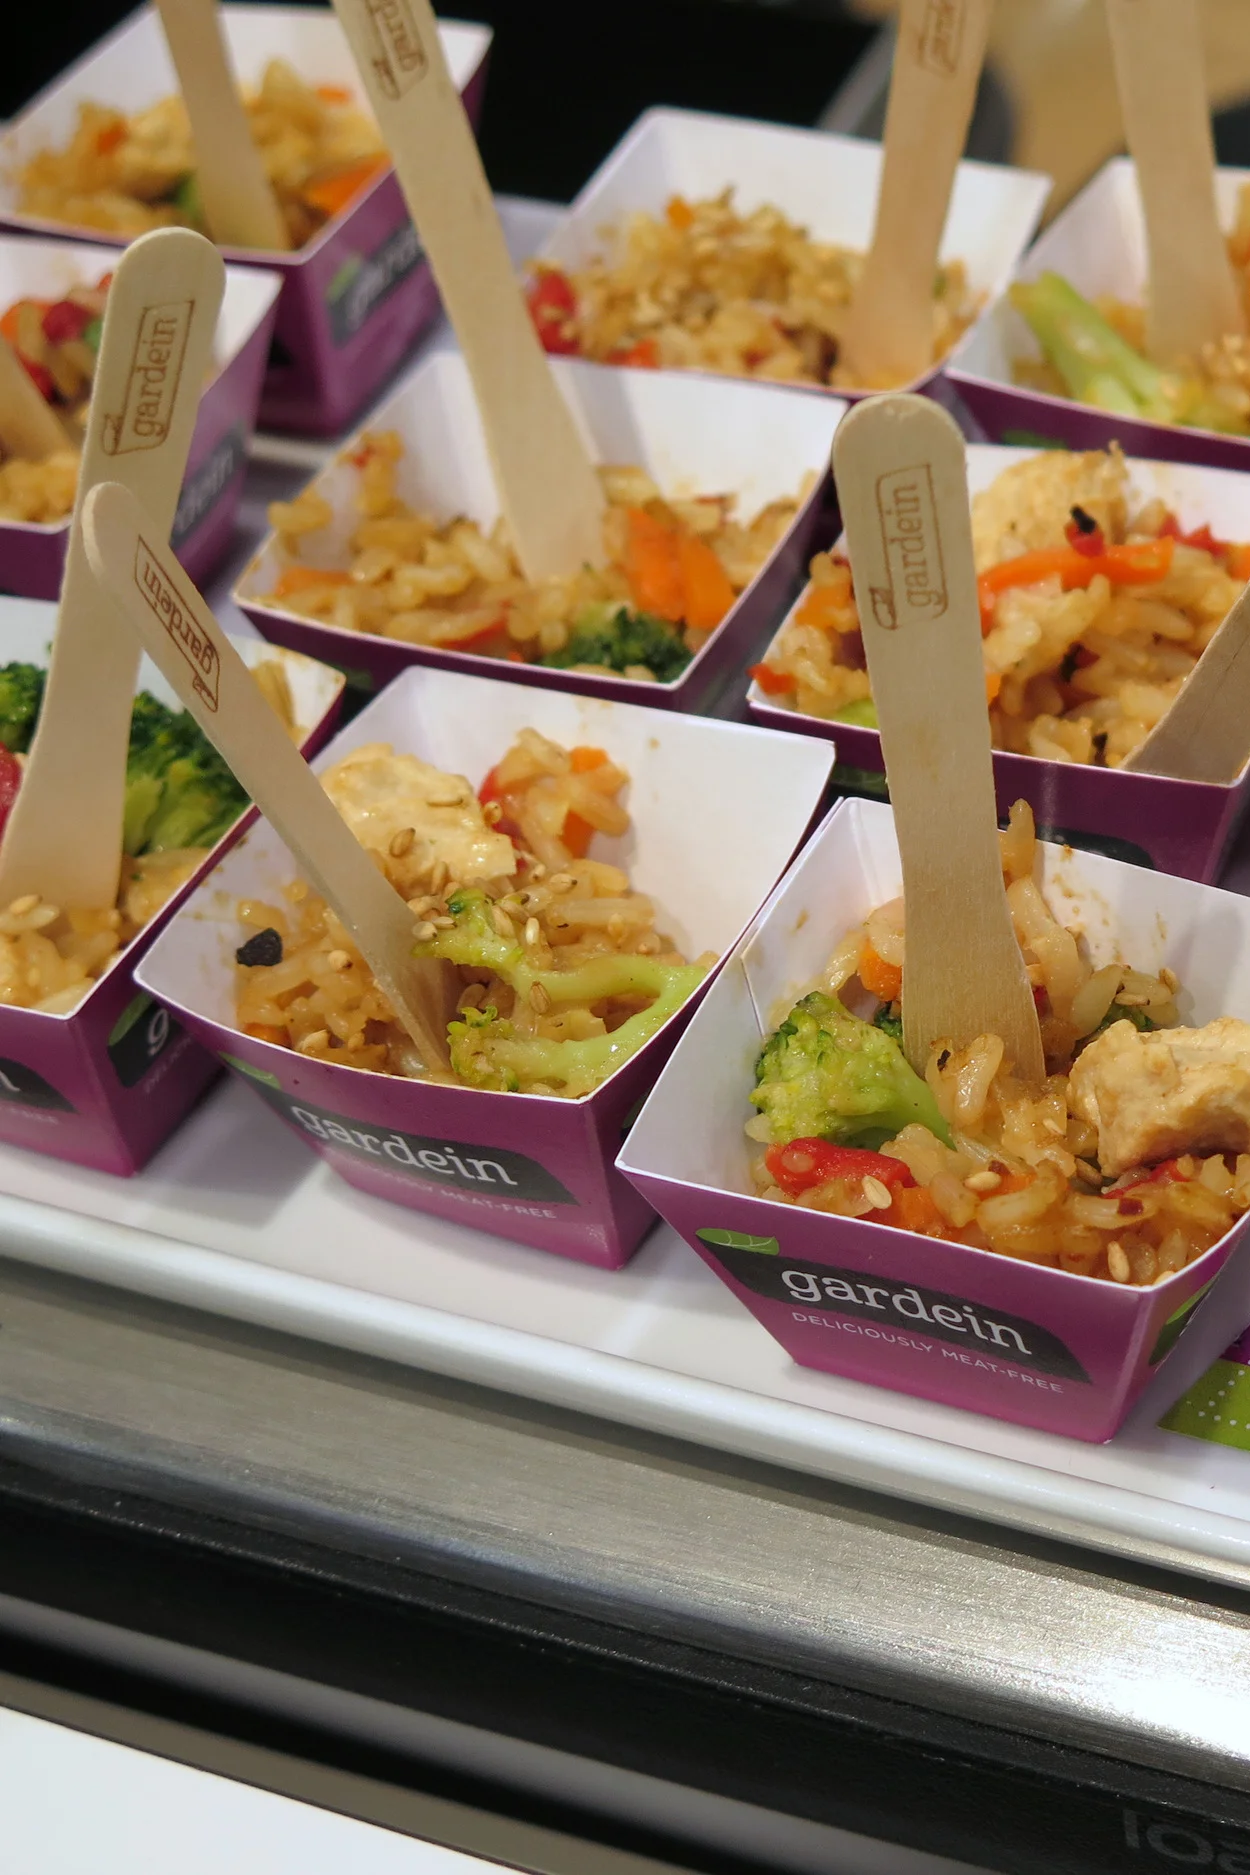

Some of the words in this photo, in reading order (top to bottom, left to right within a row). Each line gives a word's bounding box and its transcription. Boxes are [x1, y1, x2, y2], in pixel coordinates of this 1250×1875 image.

[133, 317, 177, 437] gardein
[886, 483, 945, 607] gardein
[143, 561, 215, 675] gardein
[291, 1105, 518, 1187] gardein
[781, 1268, 1032, 1356] gardein
[792, 1311, 934, 1354] DELICIOUSLY
[940, 1348, 1064, 1395] MEAT-FREE
